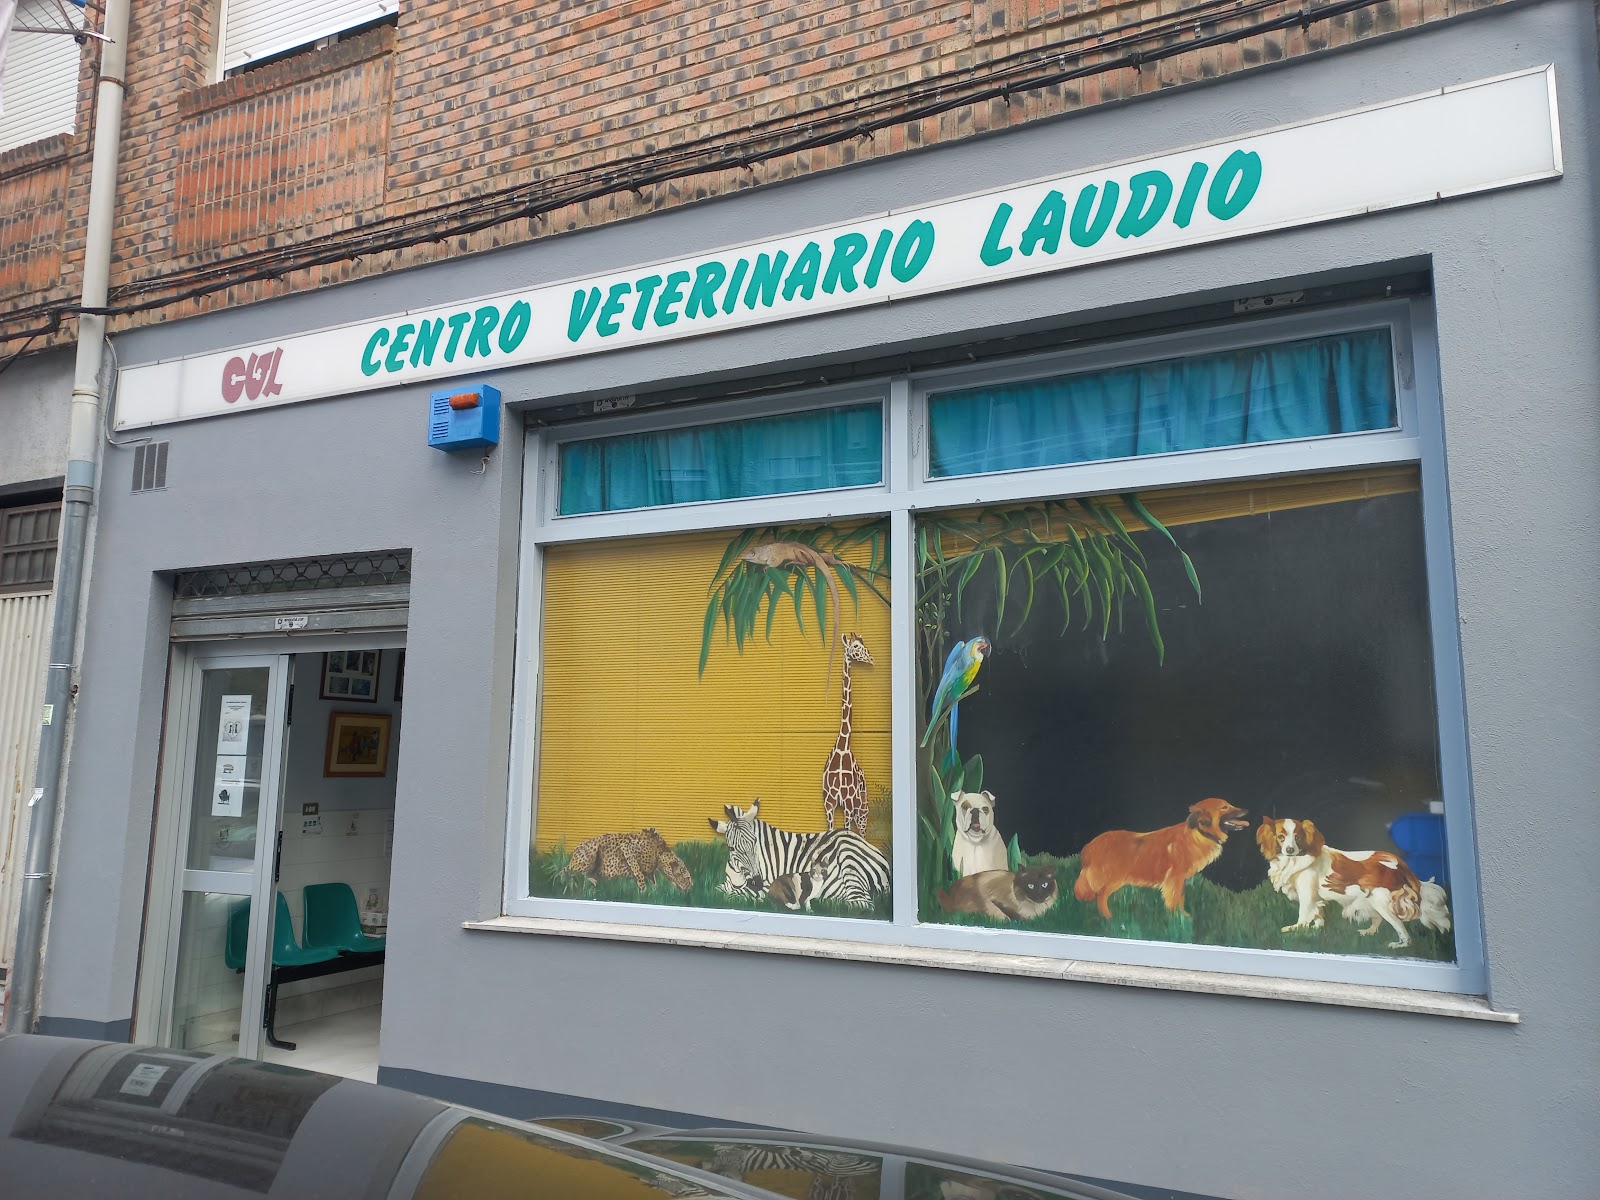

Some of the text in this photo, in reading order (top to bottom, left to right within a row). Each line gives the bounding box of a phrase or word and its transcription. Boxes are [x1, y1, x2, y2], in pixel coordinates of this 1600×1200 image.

[361, 150, 1263, 376] CENTRO VETERINARIO LAUDIO
